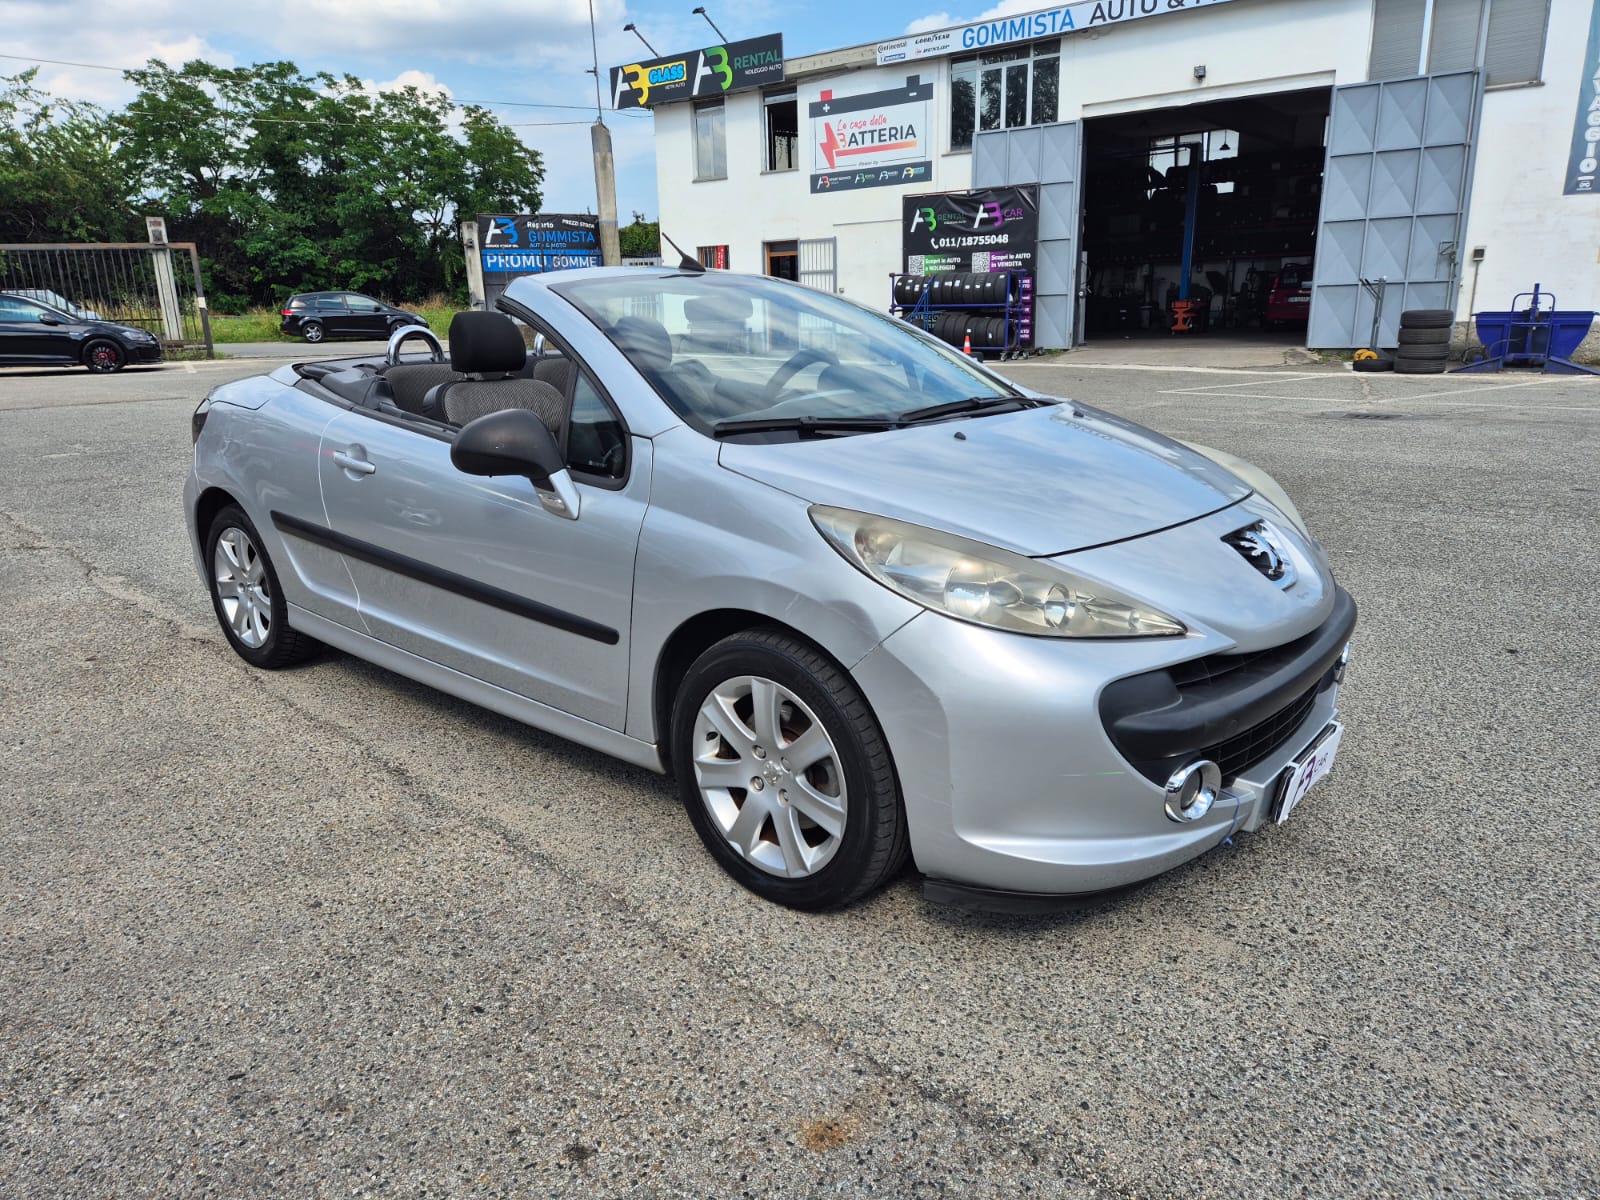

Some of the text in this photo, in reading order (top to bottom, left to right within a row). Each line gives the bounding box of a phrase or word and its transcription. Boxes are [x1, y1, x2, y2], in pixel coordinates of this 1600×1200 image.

[962, 0, 1158, 49] GOMMISTA AUTO
[733, 48, 784, 70] RENTAL
[648, 63, 685, 85] GLASS
[768, 63, 783, 72] AUTO
[1003, 208, 1023, 218] CAR
[528, 230, 596, 243] GOMMISTA
[939, 234, 1009, 248] 011/18755048
[553, 255, 598, 269] GOMME
[1015, 252, 1031, 260] AUTO
[929, 264, 956, 272] NOLEGGIO
[997, 260, 1022, 268] VENDITA
